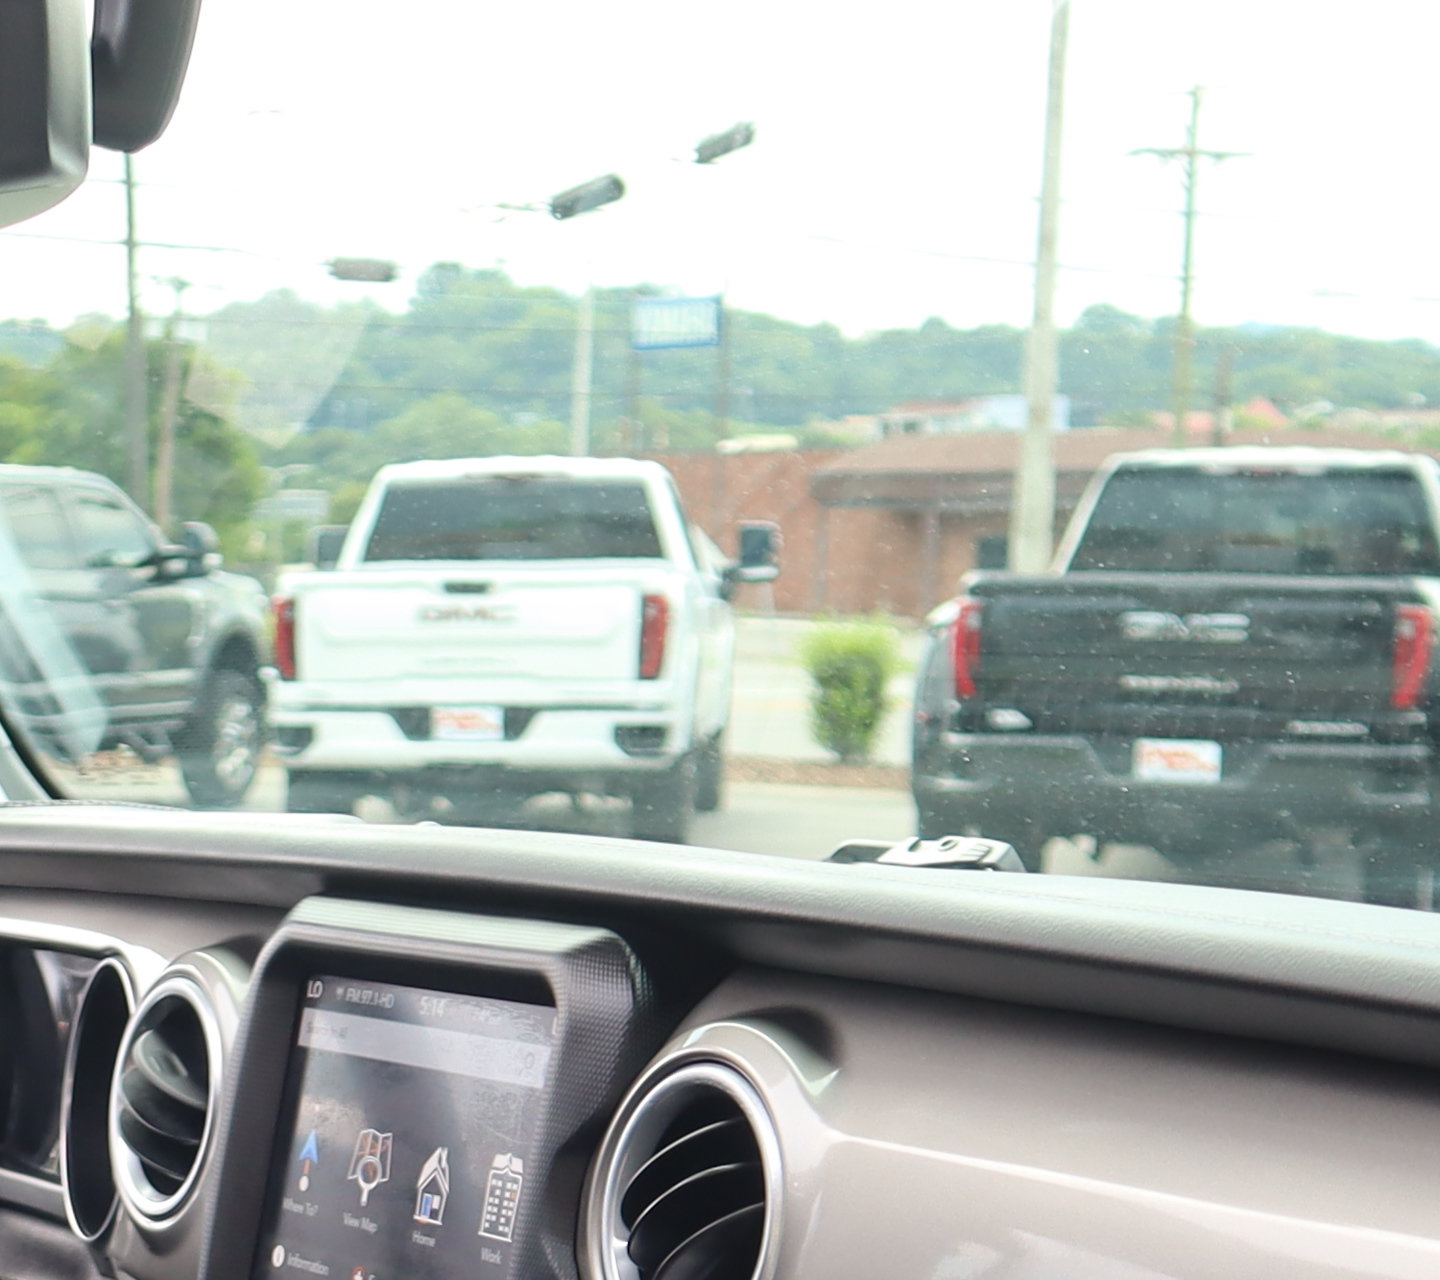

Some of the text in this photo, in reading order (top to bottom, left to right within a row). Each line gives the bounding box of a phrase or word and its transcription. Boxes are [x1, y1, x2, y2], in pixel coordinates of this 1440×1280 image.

[412, 1232, 436, 1248] Home
[286, 1252, 330, 1276] Information
[481, 1247, 502, 1265] Work
